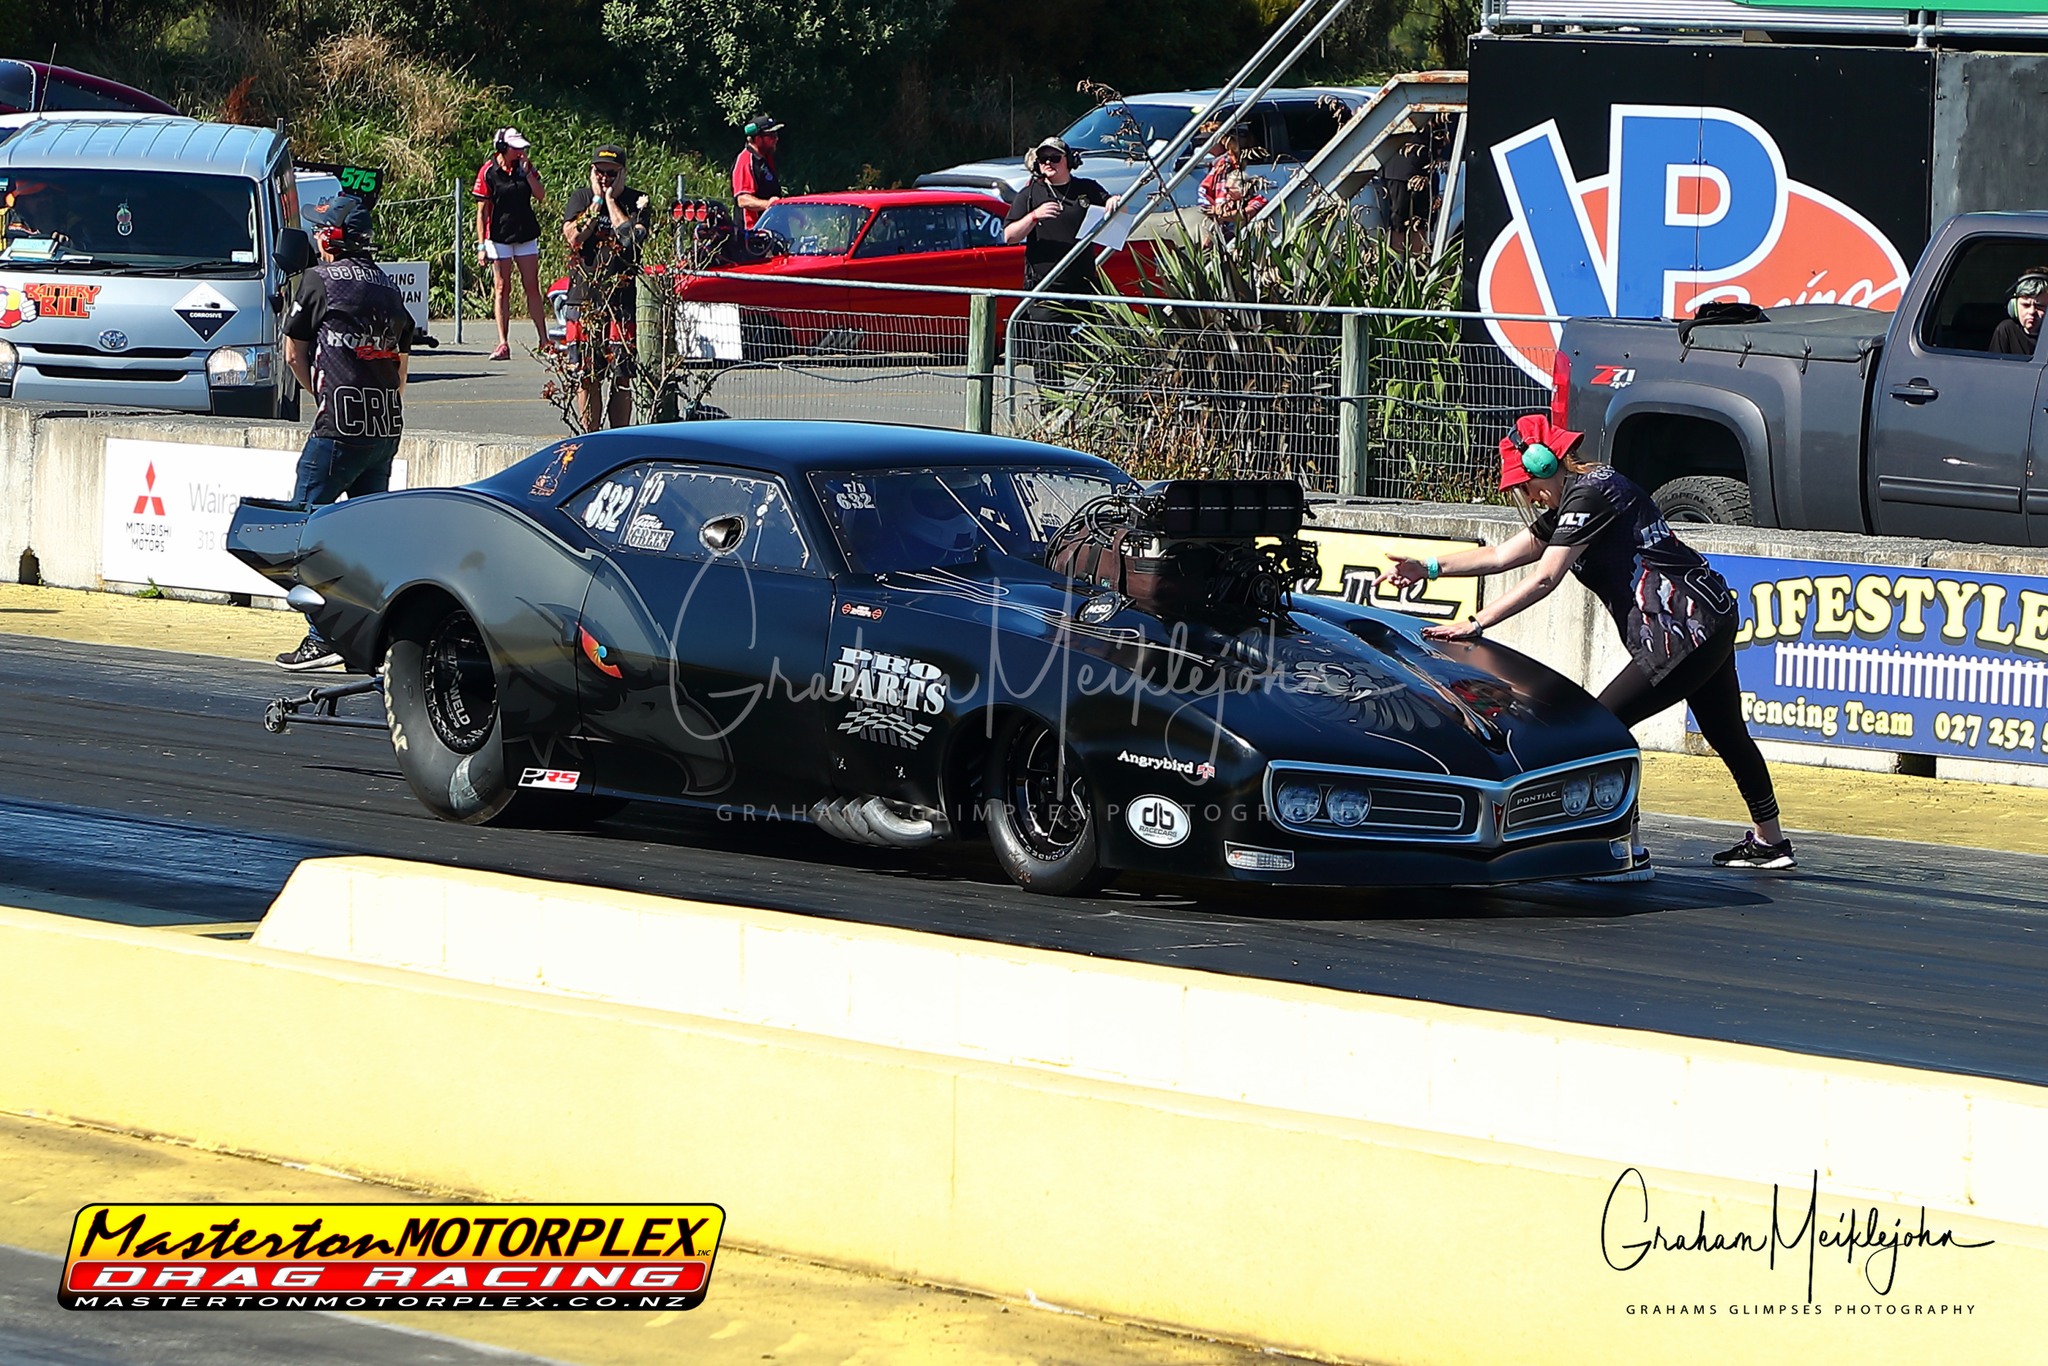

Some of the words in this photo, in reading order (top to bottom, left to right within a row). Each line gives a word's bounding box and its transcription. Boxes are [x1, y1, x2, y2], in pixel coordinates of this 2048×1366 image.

[341, 167, 376, 192] 575
[327, 266, 352, 281] 68
[23, 283, 102, 304] BATTERY
[40, 296, 89, 318] BILL
[1590, 365, 1636, 384] Z71
[189, 482, 240, 515] Waira
[583, 481, 635, 532] 632
[836, 493, 876, 510] 632
[126, 522, 172, 538] MITSUBISHI
[197, 530, 215, 551] 313
[131, 538, 165, 552] MOTORS
[1086, 603, 1111, 615] MSD
[839, 646, 942, 680] PRO
[829, 662, 947, 715] PARTS
[449, 683, 471, 725] WELD
[1740, 691, 1838, 737] Fencing
[1845, 700, 1913, 737] Team
[1934, 711, 1982, 747] 027
[1988, 716, 2035, 750] 252
[1117, 749, 1194, 774] Angrybird
[1516, 790, 1558, 806] PONTIAC
[1142, 801, 1175, 830] db
[1139, 825, 1178, 838] RACECARS
